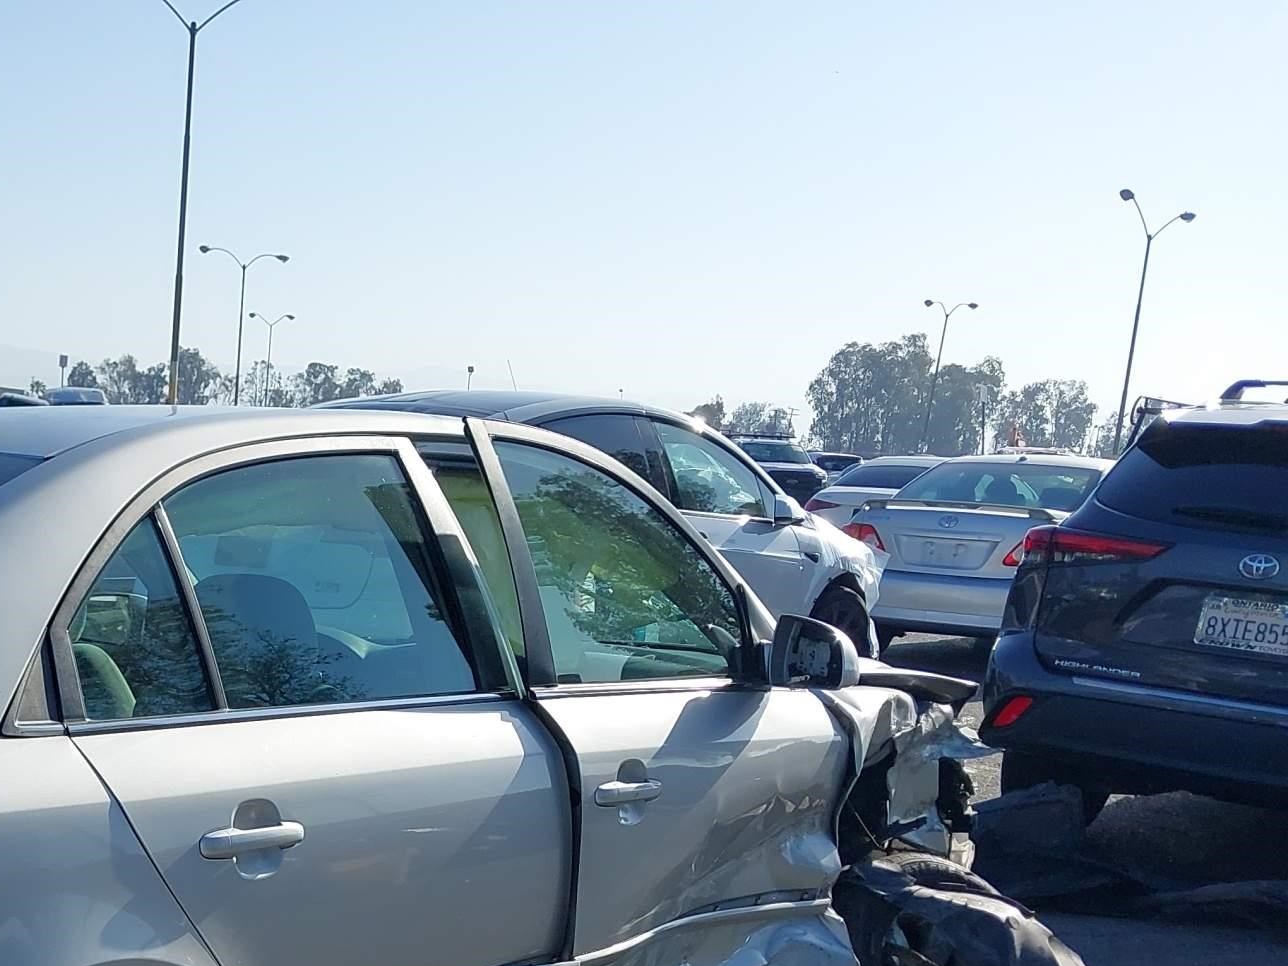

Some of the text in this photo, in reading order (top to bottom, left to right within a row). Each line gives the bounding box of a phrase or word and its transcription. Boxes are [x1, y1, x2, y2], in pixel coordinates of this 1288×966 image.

[1232, 599, 1280, 610] ONTARIO
[1205, 615, 1288, 646] 8XIE855
[1054, 659, 1141, 678] HIGHLANDER
